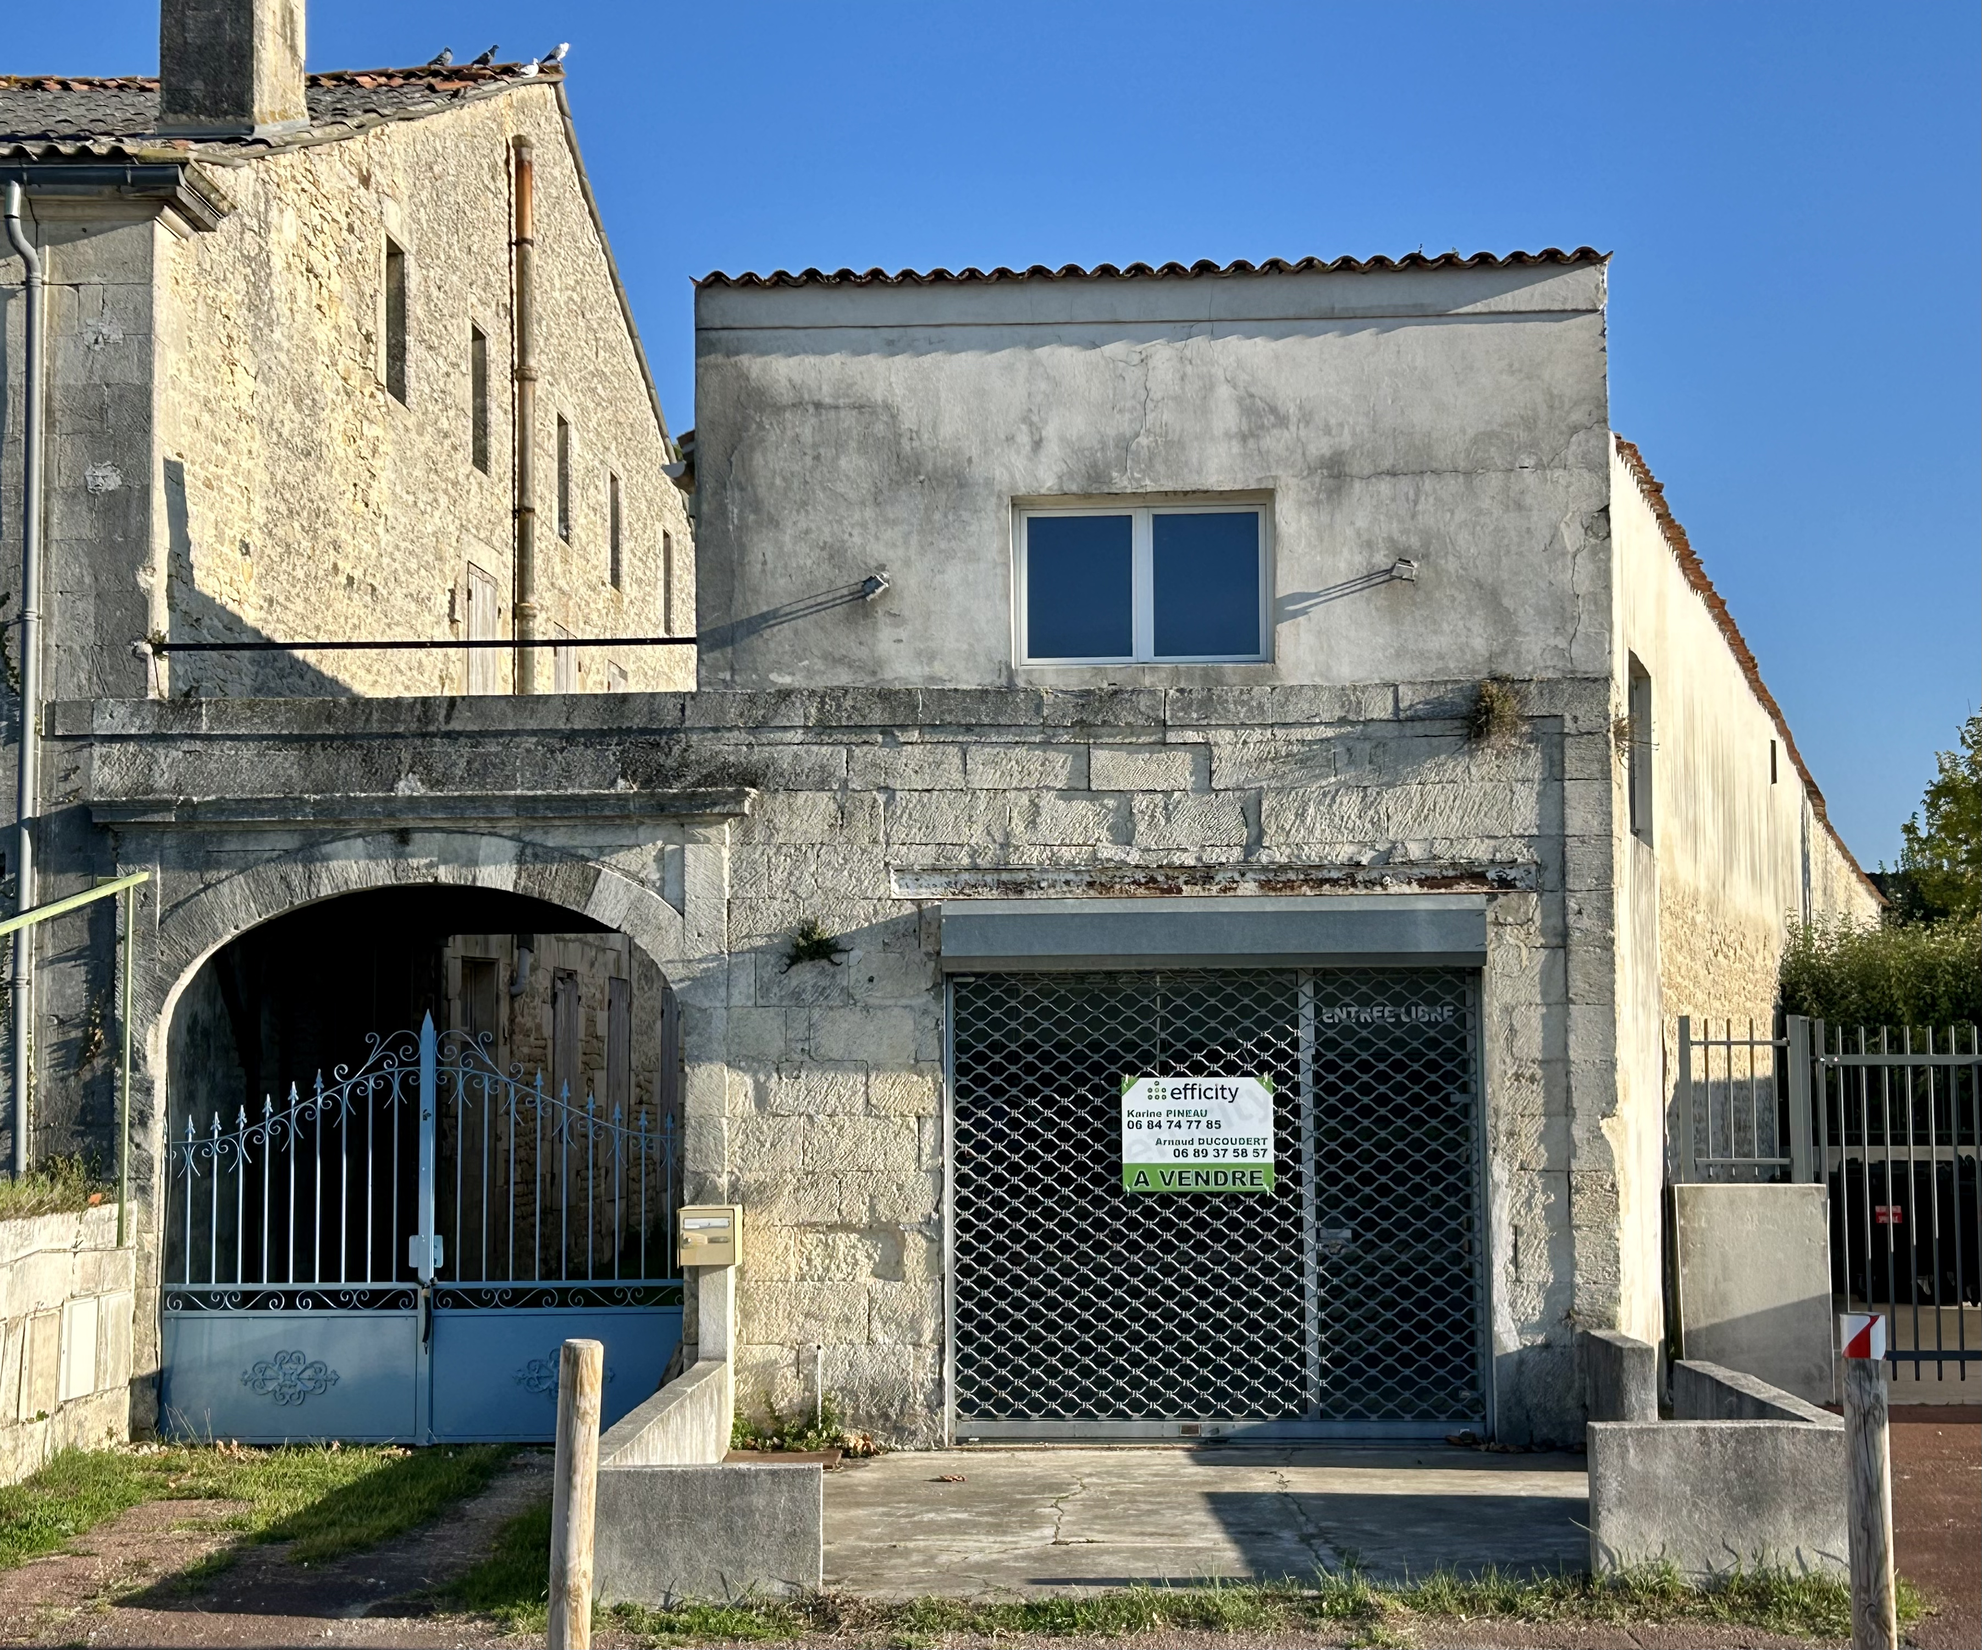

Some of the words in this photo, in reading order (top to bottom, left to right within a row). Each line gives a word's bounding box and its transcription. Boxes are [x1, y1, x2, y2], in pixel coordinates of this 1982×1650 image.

[1170, 1083, 1239, 1104] efficity
[1126, 1109, 1163, 1118] Karine
[1166, 1109, 1208, 1118] PINEAU
[1126, 1119, 1143, 1130] 06
[1146, 1119, 1163, 1130] 84
[1166, 1119, 1182, 1130] 74
[1186, 1119, 1202, 1130] 77
[1206, 1119, 1222, 1130] 85
[1155, 1137, 1194, 1146] Arnaud
[1173, 1148, 1189, 1158] 06
[1192, 1148, 1209, 1158] 89
[1212, 1148, 1228, 1158] 37
[1232, 1148, 1248, 1158] 58
[1252, 1148, 1268, 1158] 57
[1133, 1170, 1150, 1187] A
[1159, 1170, 1263, 1187] VENDRE
